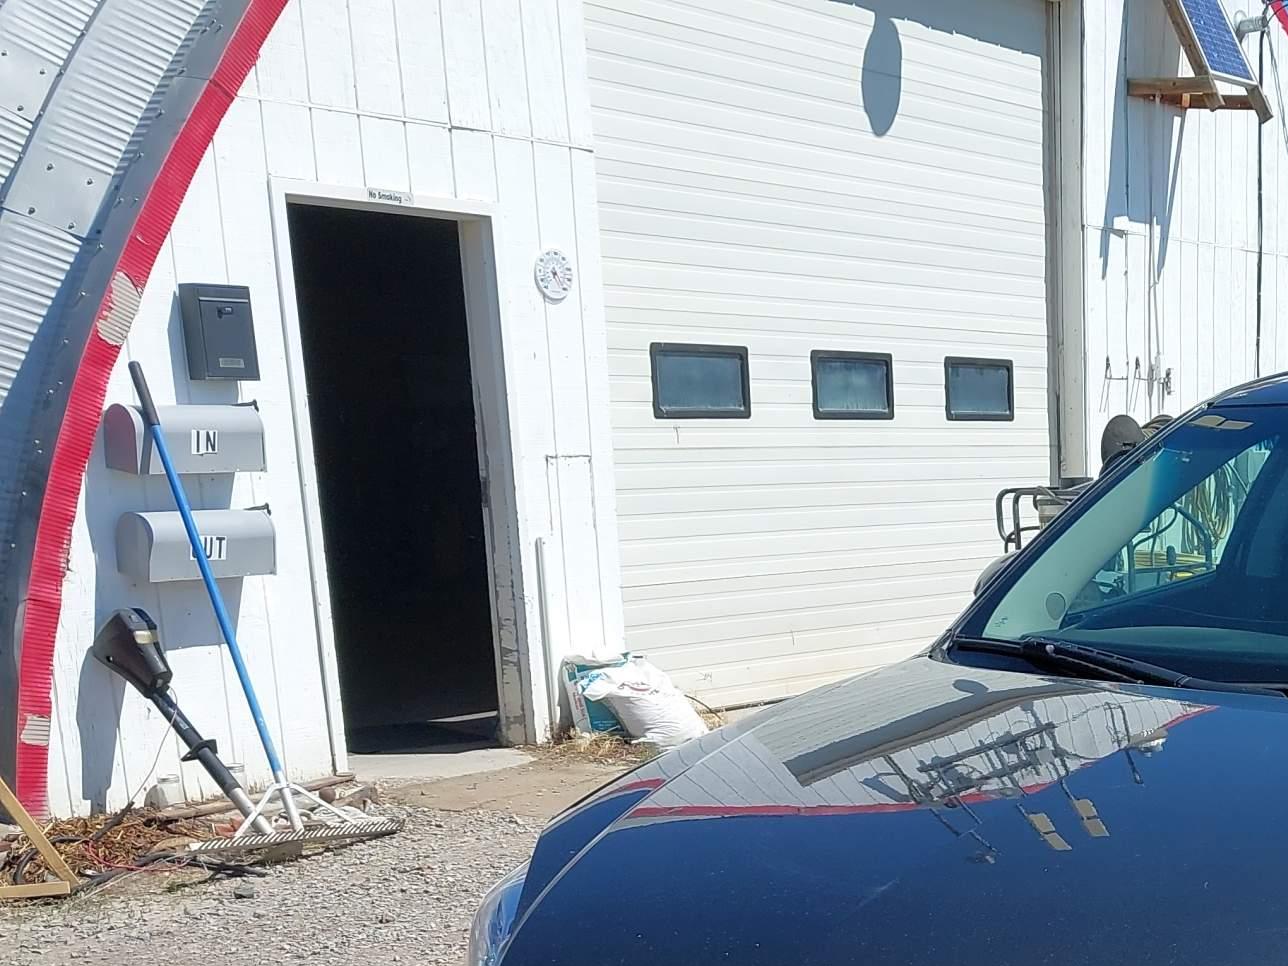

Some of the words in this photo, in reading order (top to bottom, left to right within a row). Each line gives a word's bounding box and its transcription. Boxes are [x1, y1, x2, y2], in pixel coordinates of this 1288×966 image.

[368, 190, 377, 199] No
[377, 191, 402, 204] Smoking
[196, 430, 217, 453] IN
